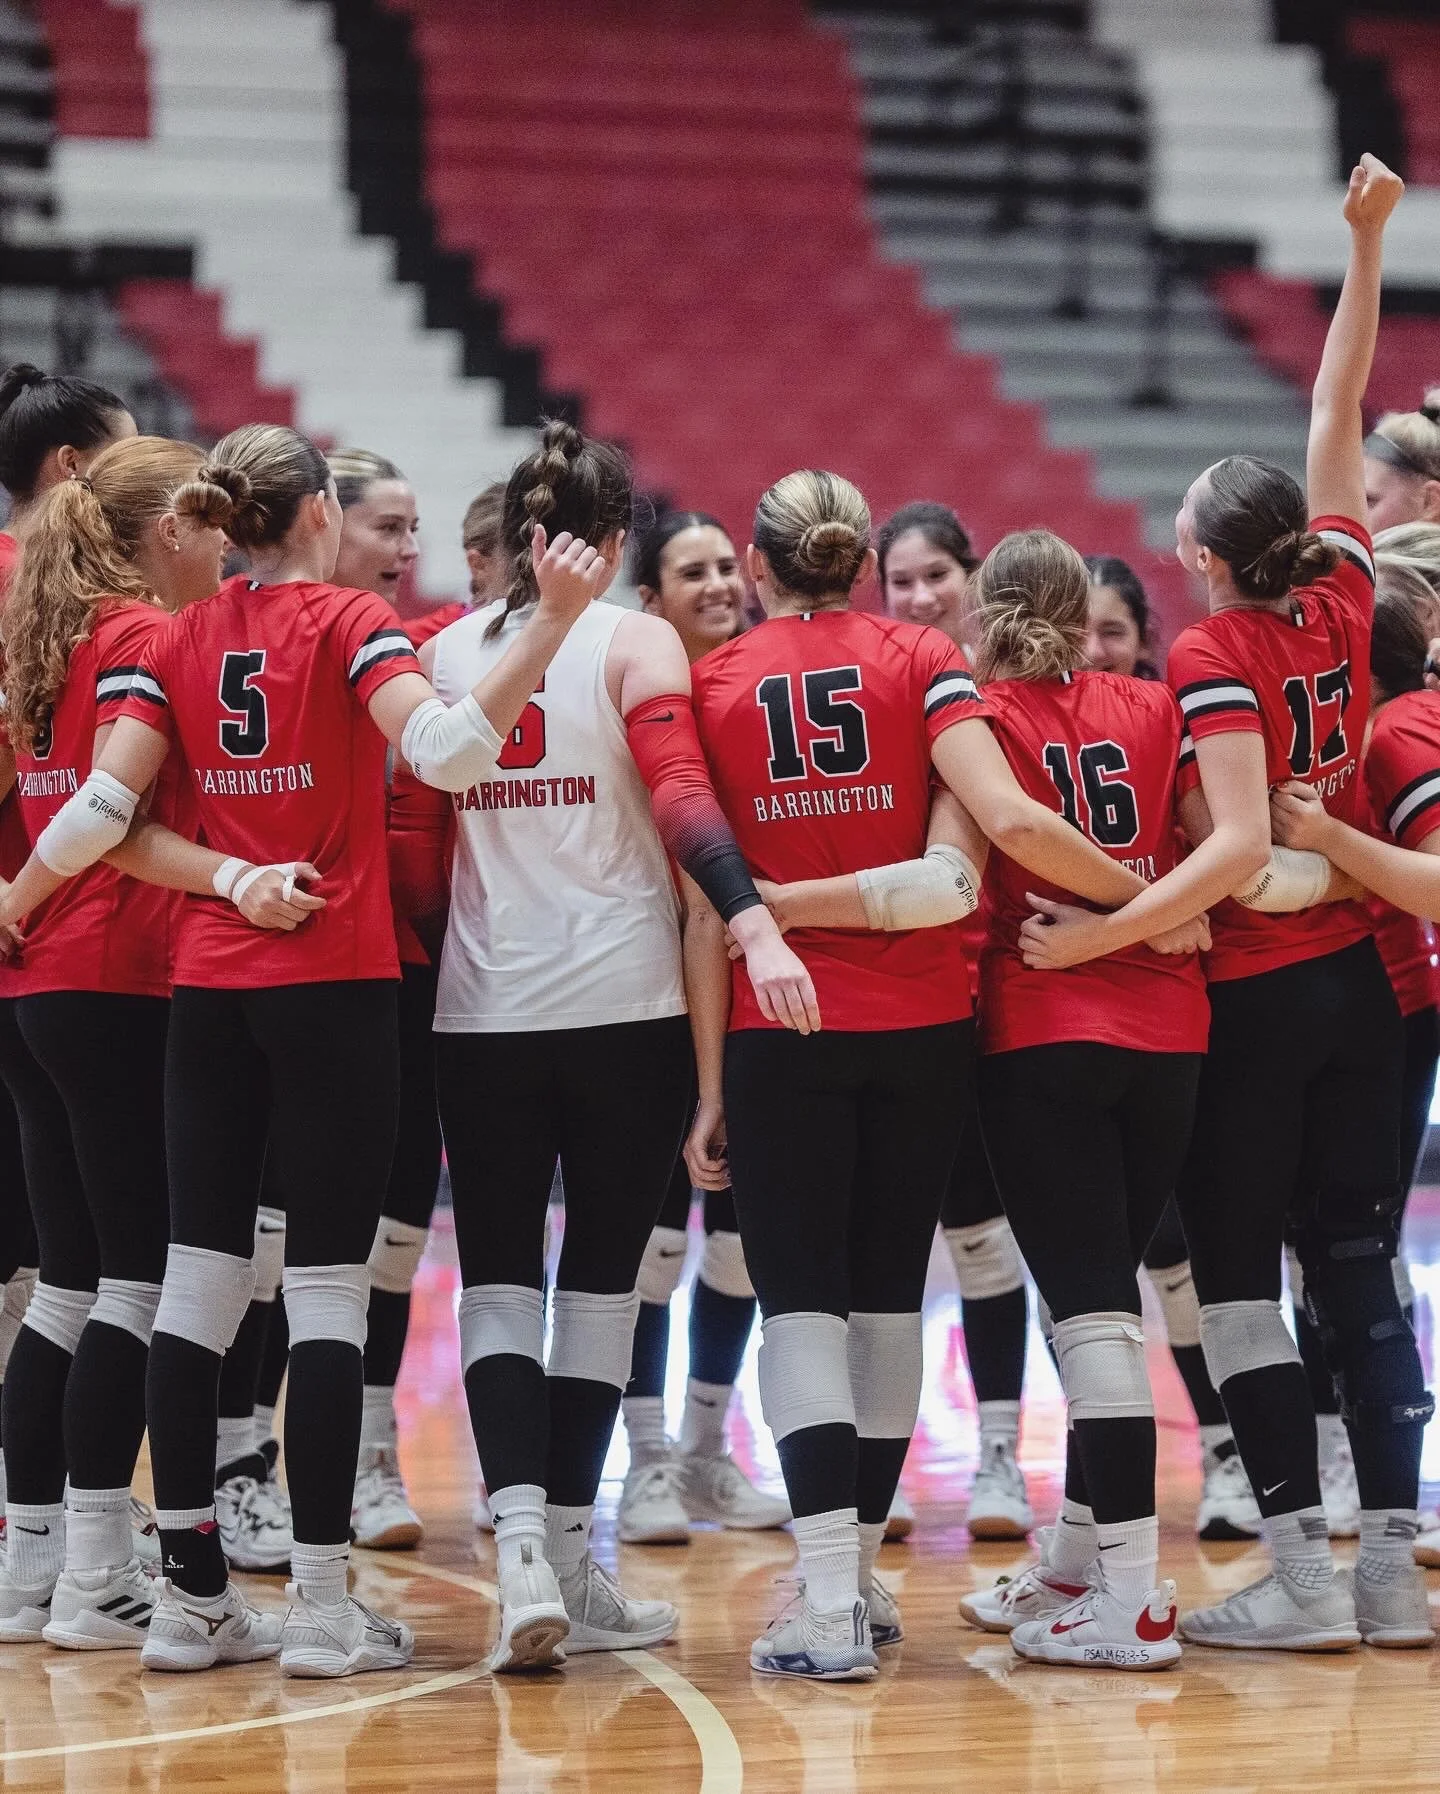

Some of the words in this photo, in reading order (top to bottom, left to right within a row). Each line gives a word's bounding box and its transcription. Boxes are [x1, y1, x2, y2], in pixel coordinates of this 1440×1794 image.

[218, 650, 269, 758] 5
[756, 665, 870, 783] 15
[1282, 659, 1352, 777] 17
[92, 793, 129, 825] Tandem
[195, 763, 314, 795] ARRINGTON
[754, 784, 894, 822] BARRINGTON
[1042, 740, 1139, 848] 16
[1084, 1648, 1113, 1661] PSALM
